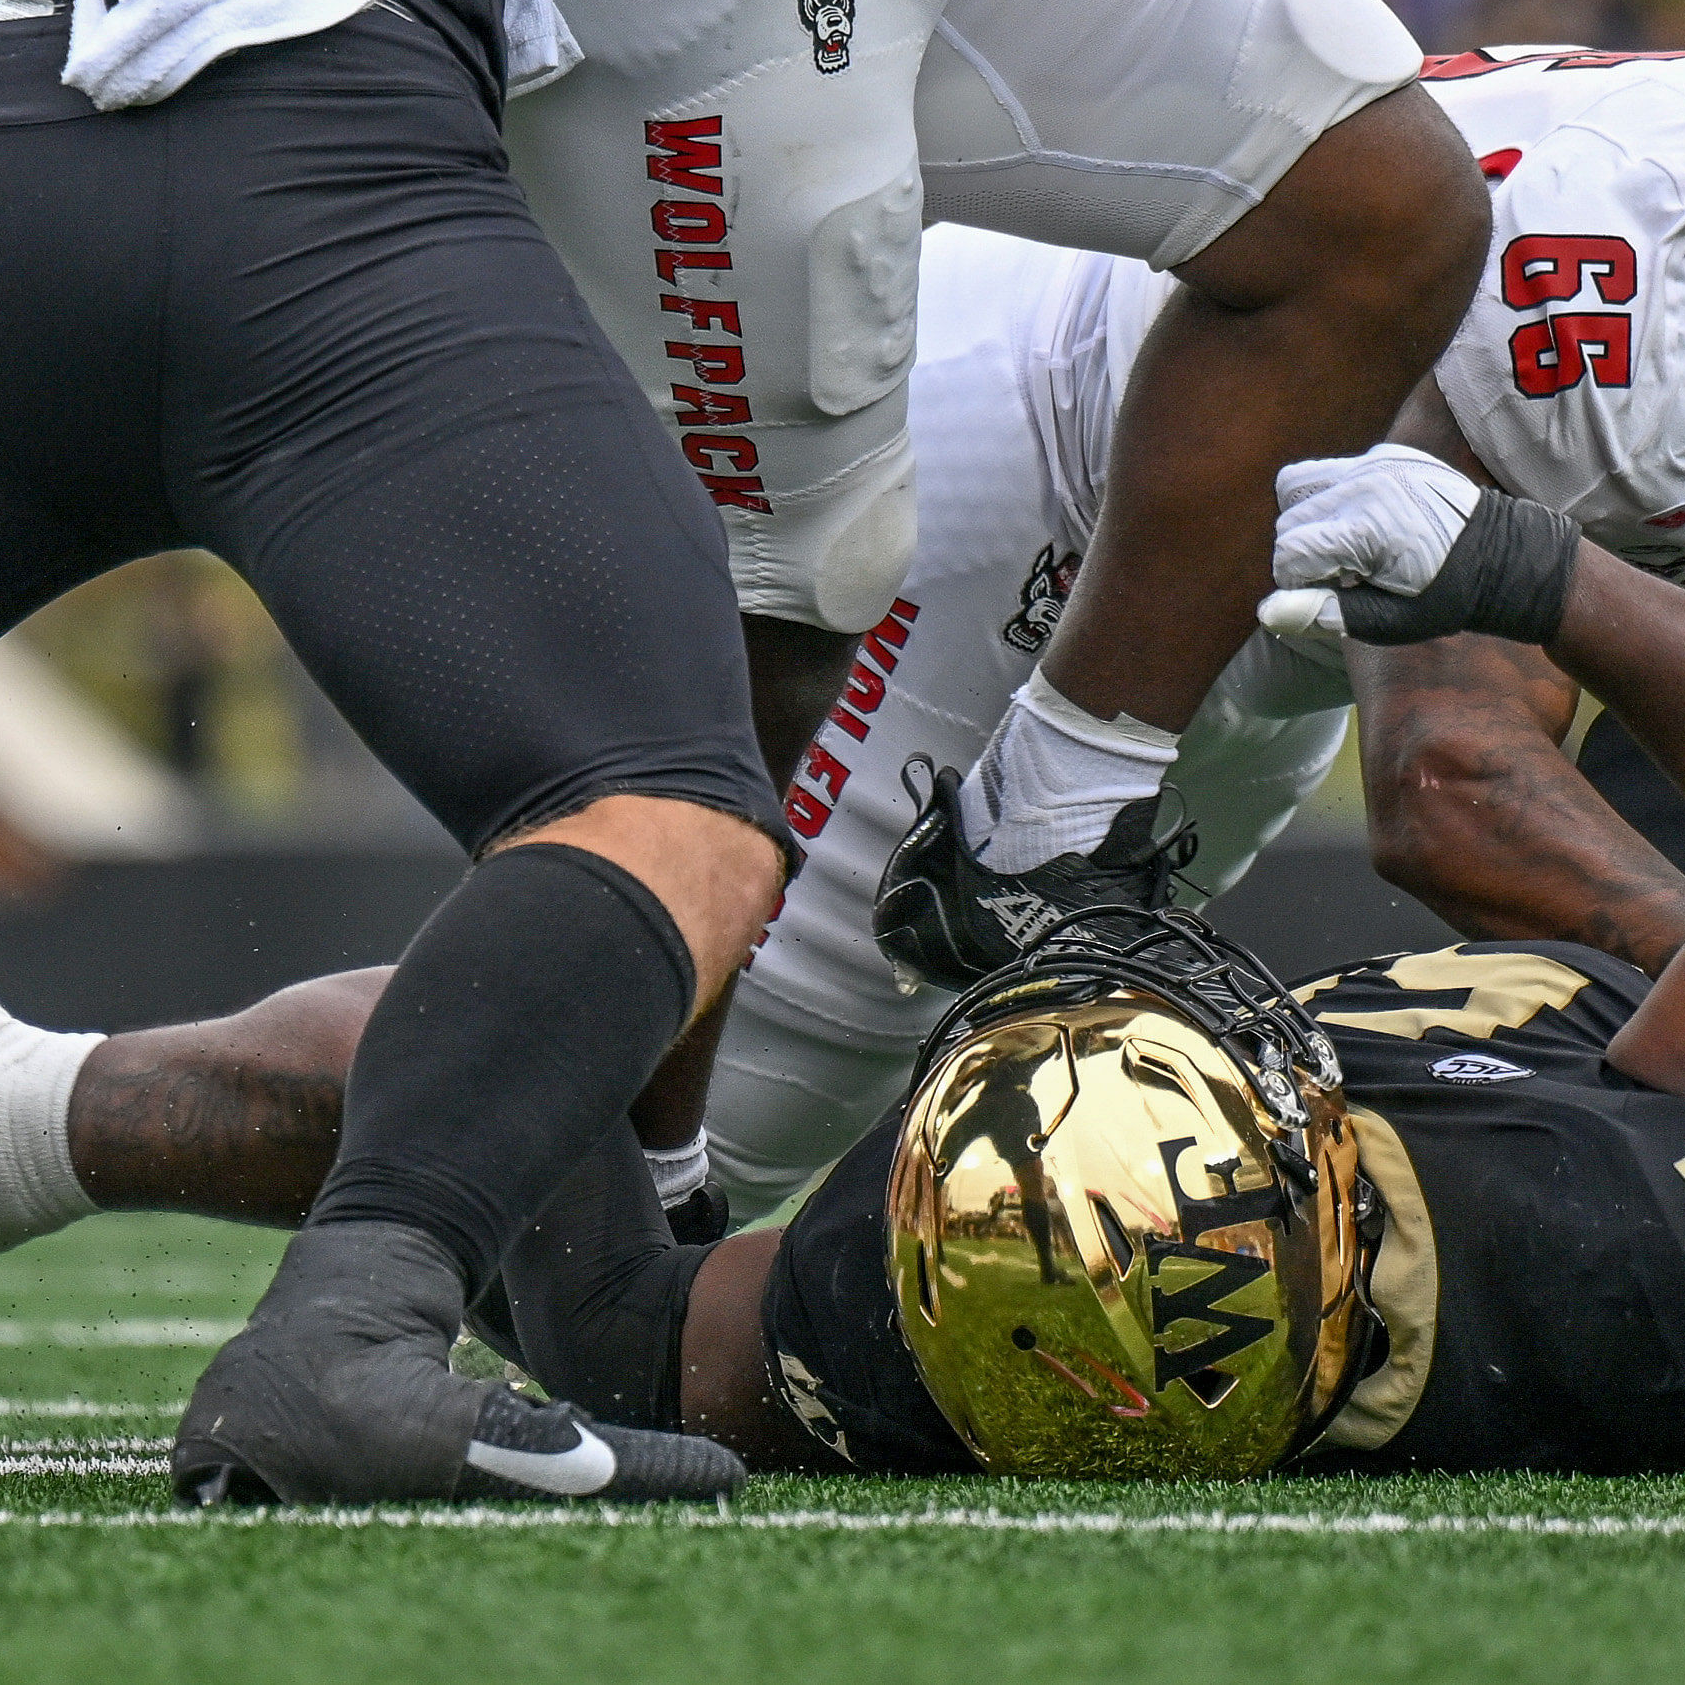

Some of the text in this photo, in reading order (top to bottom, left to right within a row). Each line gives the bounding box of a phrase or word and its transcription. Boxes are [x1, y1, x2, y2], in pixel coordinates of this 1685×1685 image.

[644, 115, 774, 515] WOLFPACK
[1501, 233, 1637, 400] 65
[1142, 1136, 1291, 1393] WF
